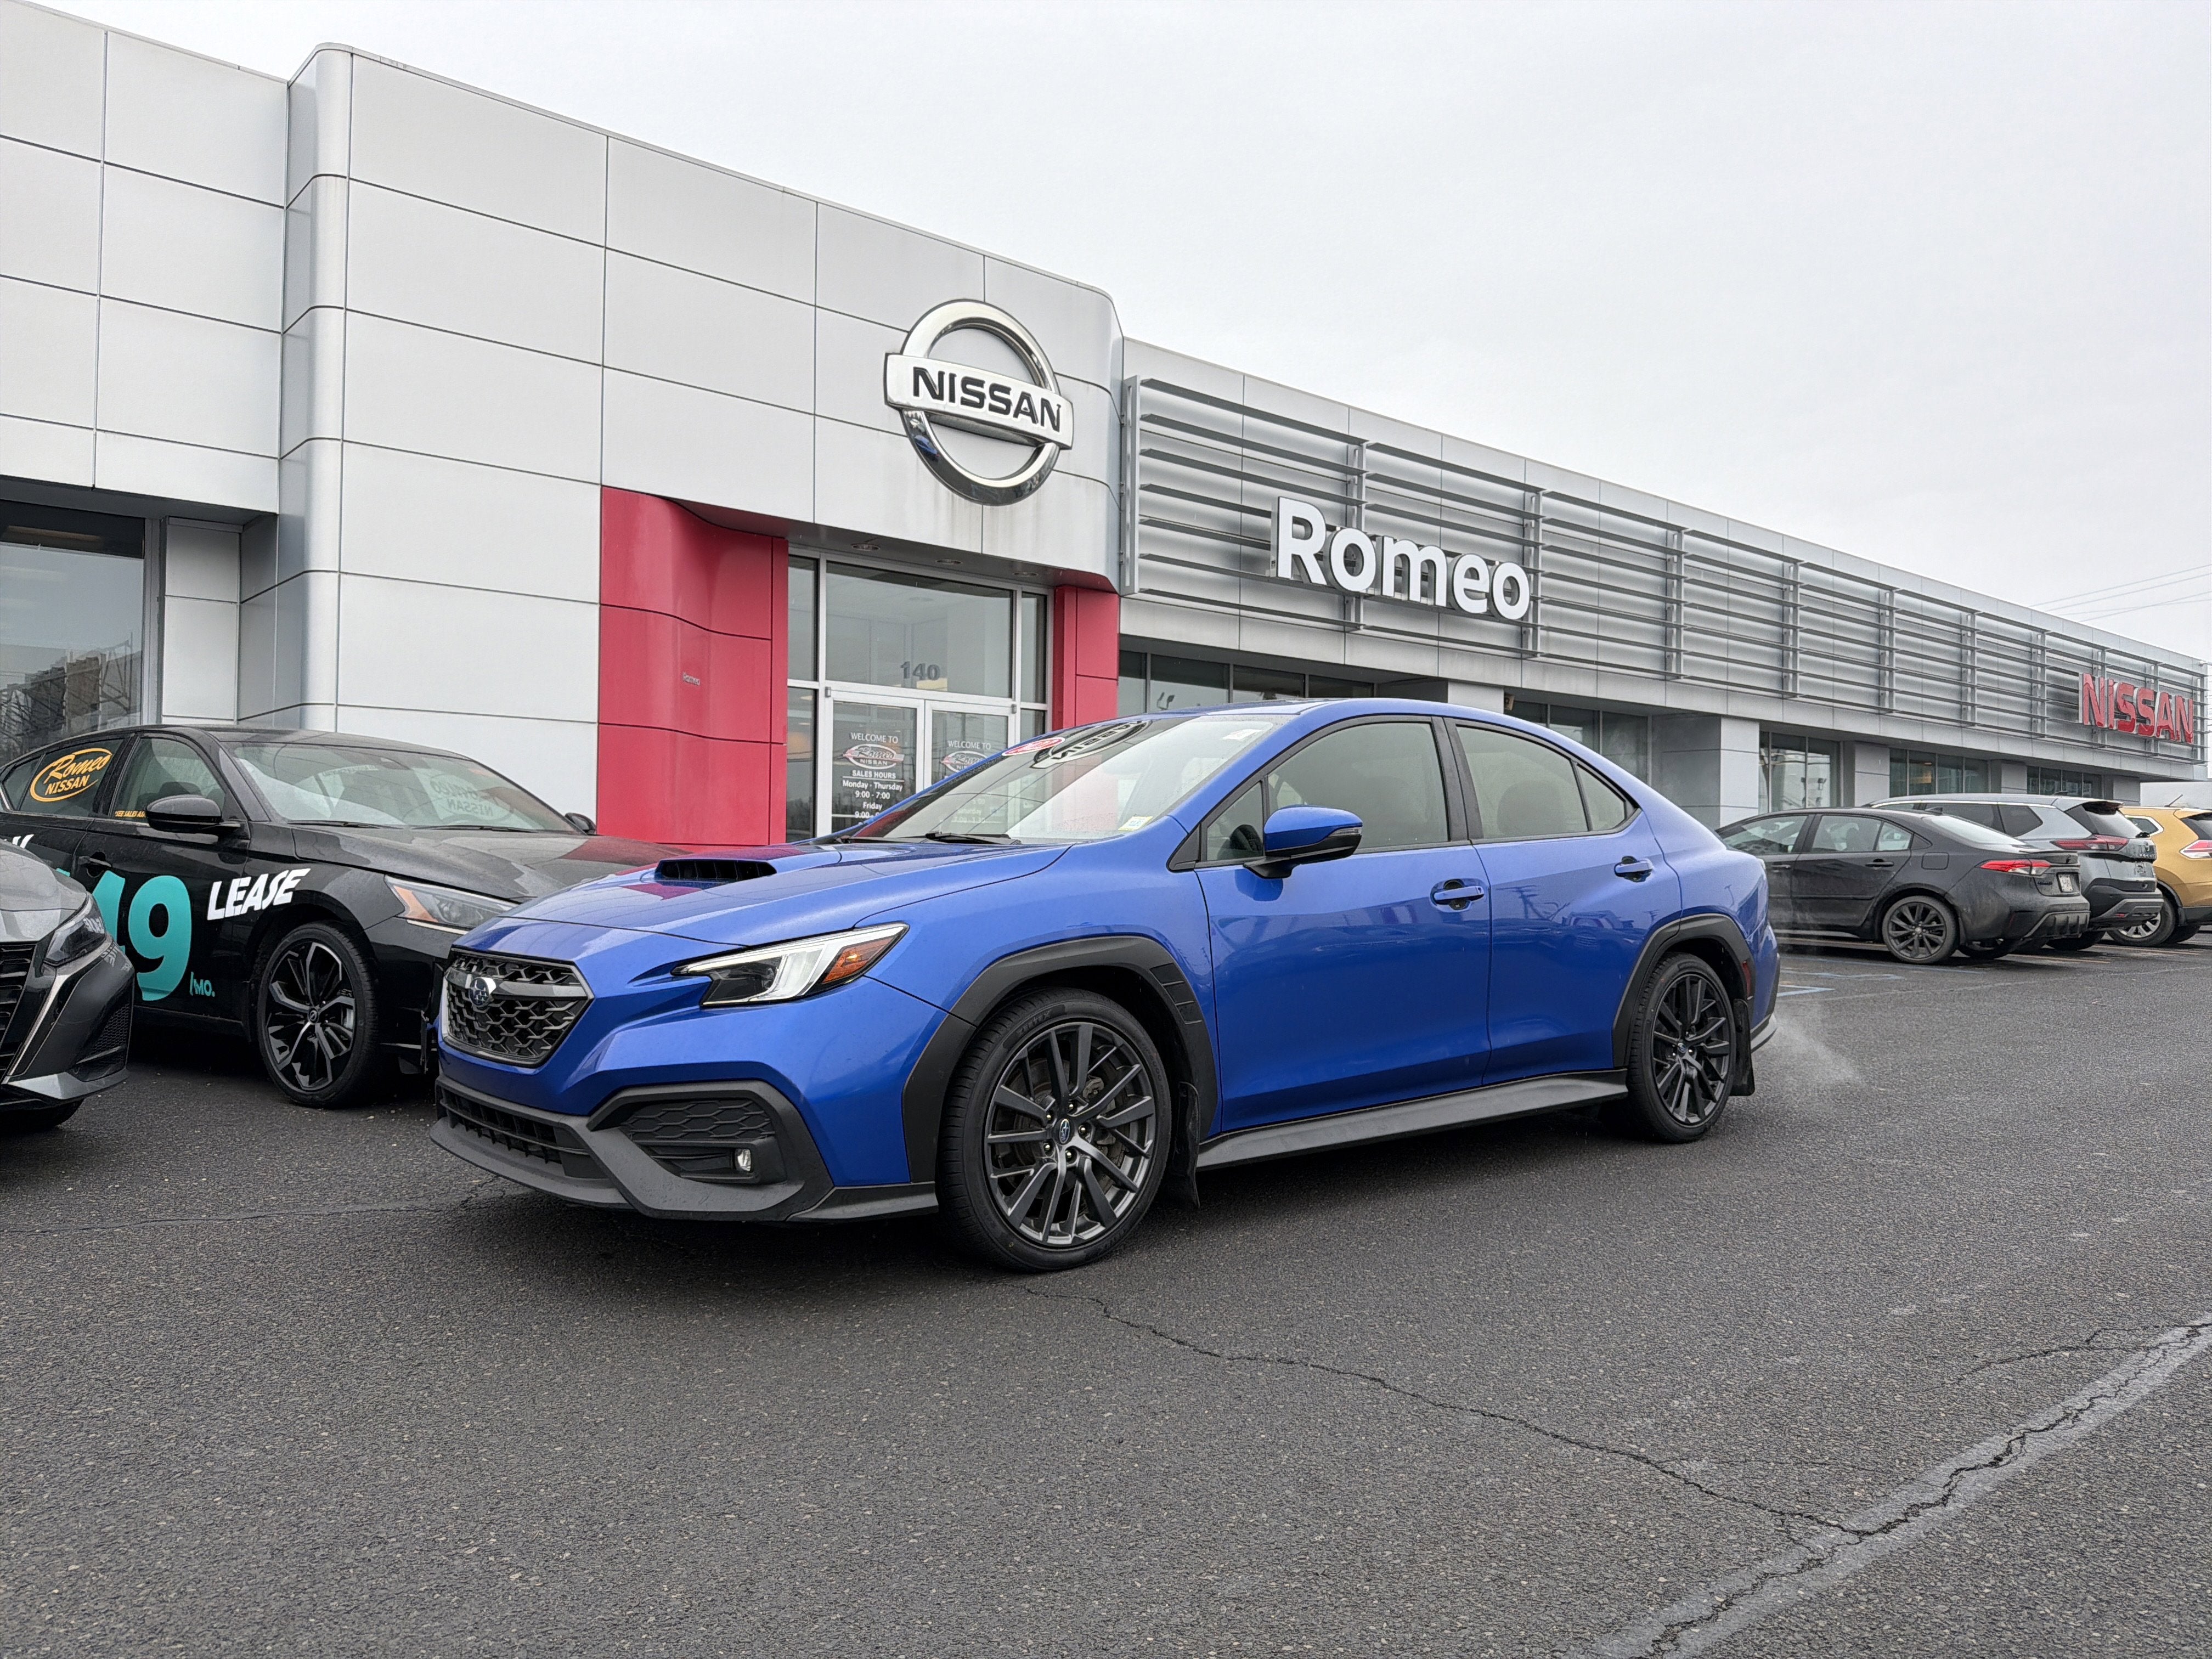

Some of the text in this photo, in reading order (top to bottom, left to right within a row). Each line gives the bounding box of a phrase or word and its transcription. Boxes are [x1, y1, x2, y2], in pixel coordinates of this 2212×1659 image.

[912, 366, 1062, 433] NISSAN
[1276, 495, 1530, 620] Romeo
[900, 661, 940, 681] 140
[2081, 673, 2194, 744] NISSAN
[851, 732, 899, 743] WELCOME TO
[947, 740, 981, 749] WELCOME
[857, 746, 895, 759] Romeo
[43, 754, 111, 785] Romeo
[44, 774, 91, 795] NISSAN
[843, 780, 868, 789] Monday
[874, 782, 903, 792] Thursday
[863, 802, 883, 810] Friday
[207, 868, 311, 921] LEASE
[190, 972, 216, 997] /MO.
